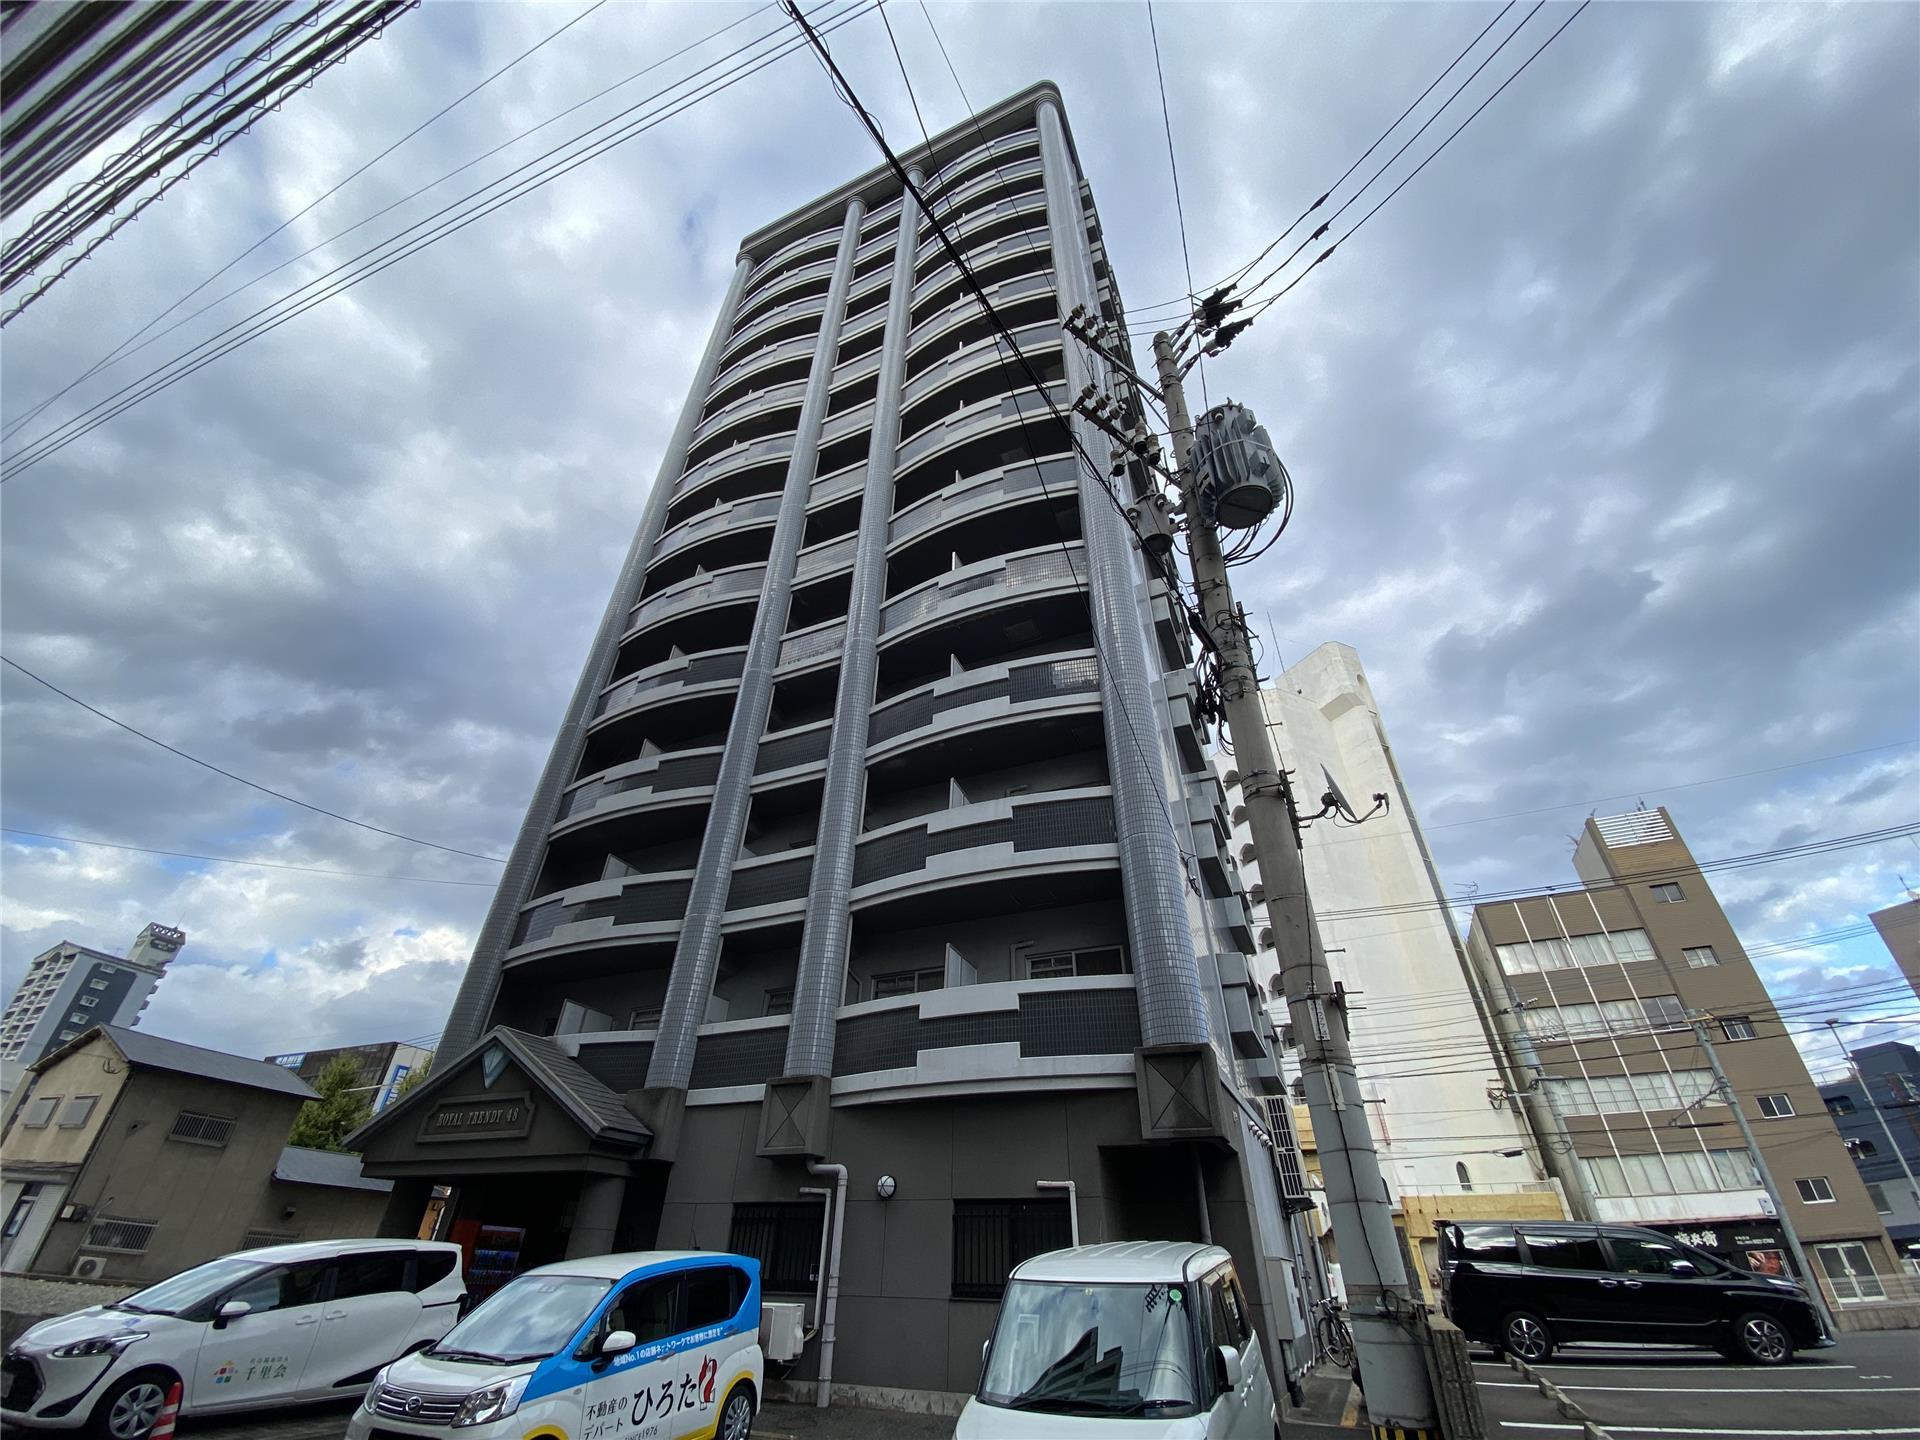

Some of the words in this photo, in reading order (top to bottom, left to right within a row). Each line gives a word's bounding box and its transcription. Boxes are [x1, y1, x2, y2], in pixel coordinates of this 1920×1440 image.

[436, 1112, 463, 1127] ROYAL
[467, 1109, 503, 1125] TRENDY
[506, 1107, 519, 1122] 48
[586, 1397, 628, 1421] 不動産の
[631, 1373, 697, 1425] ひろた
[584, 1417, 624, 1440] デパート
